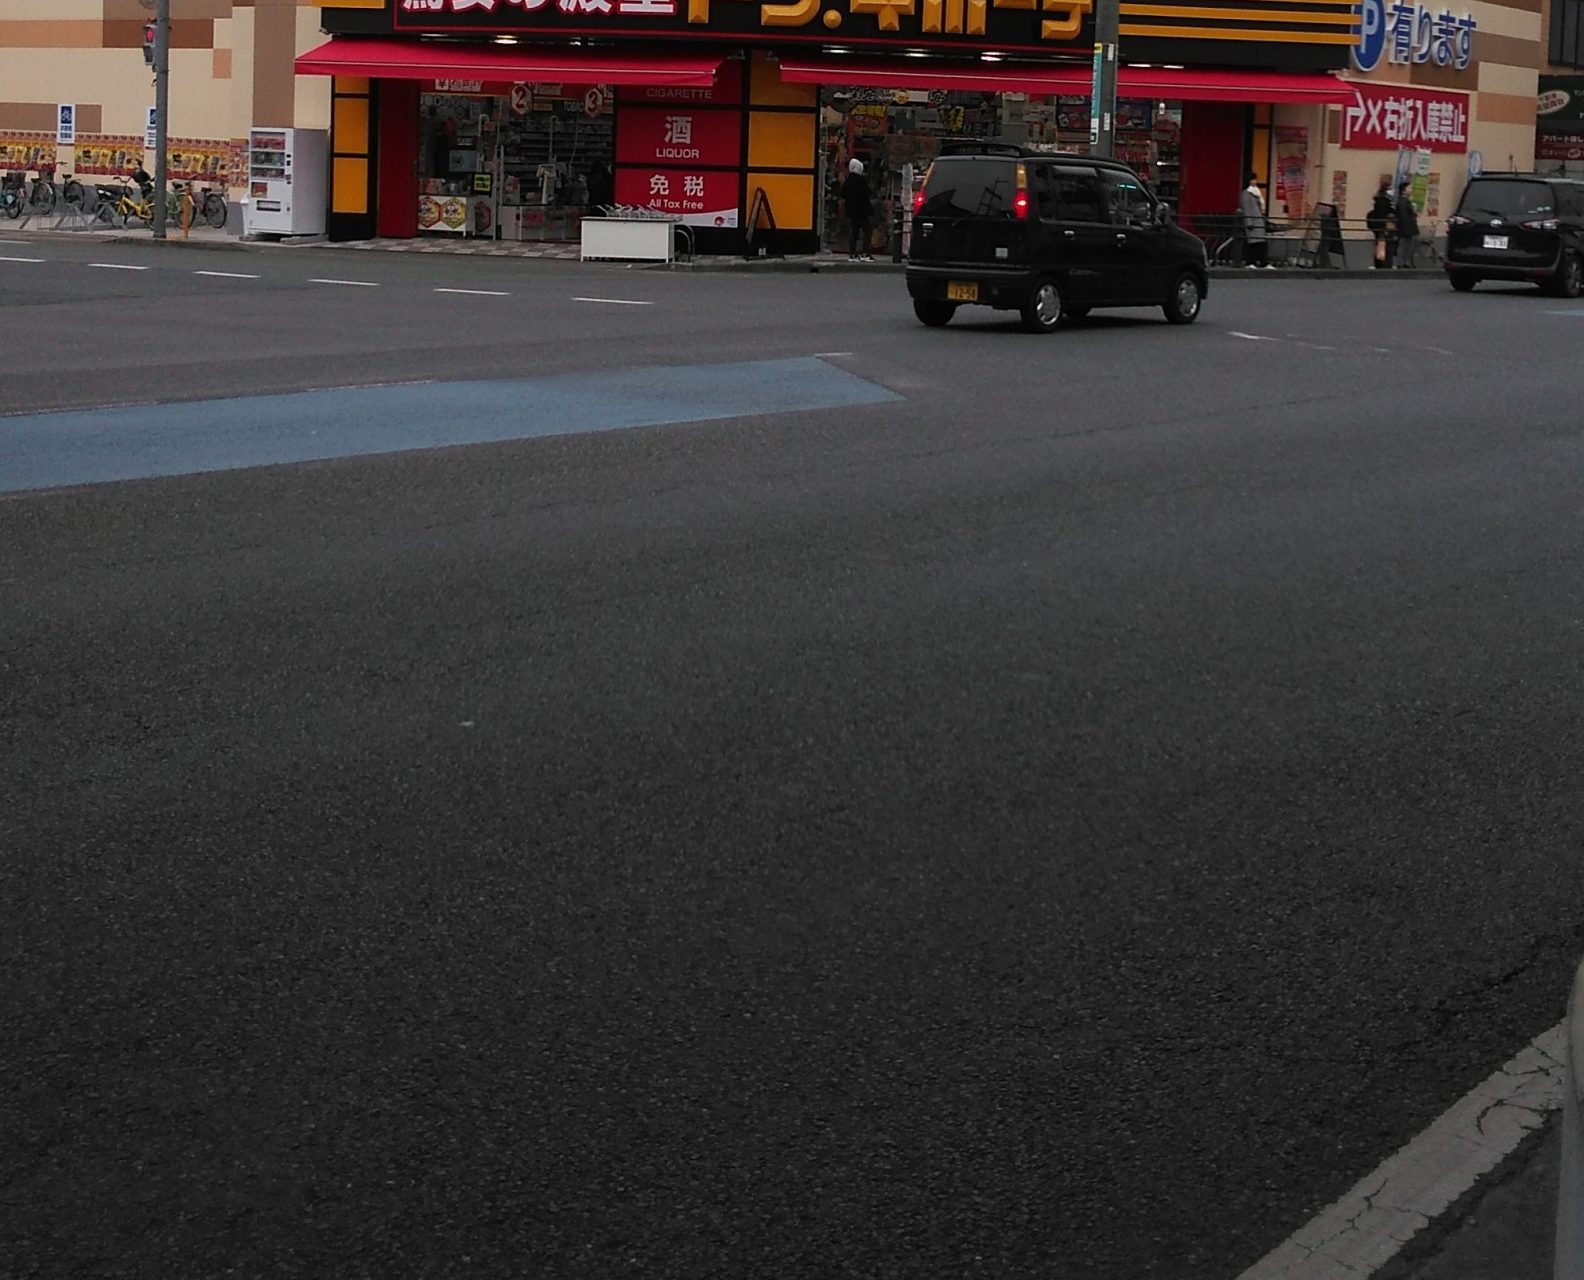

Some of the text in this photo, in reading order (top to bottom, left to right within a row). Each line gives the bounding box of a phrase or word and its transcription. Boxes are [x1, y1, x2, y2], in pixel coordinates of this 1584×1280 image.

[646, 88, 712, 99] CIGARETTE
[664, 115, 692, 144] 酒
[656, 148, 700, 159] LIQUOR
[649, 174, 704, 197] 免税
[650, 199, 704, 209] All Tax Free
